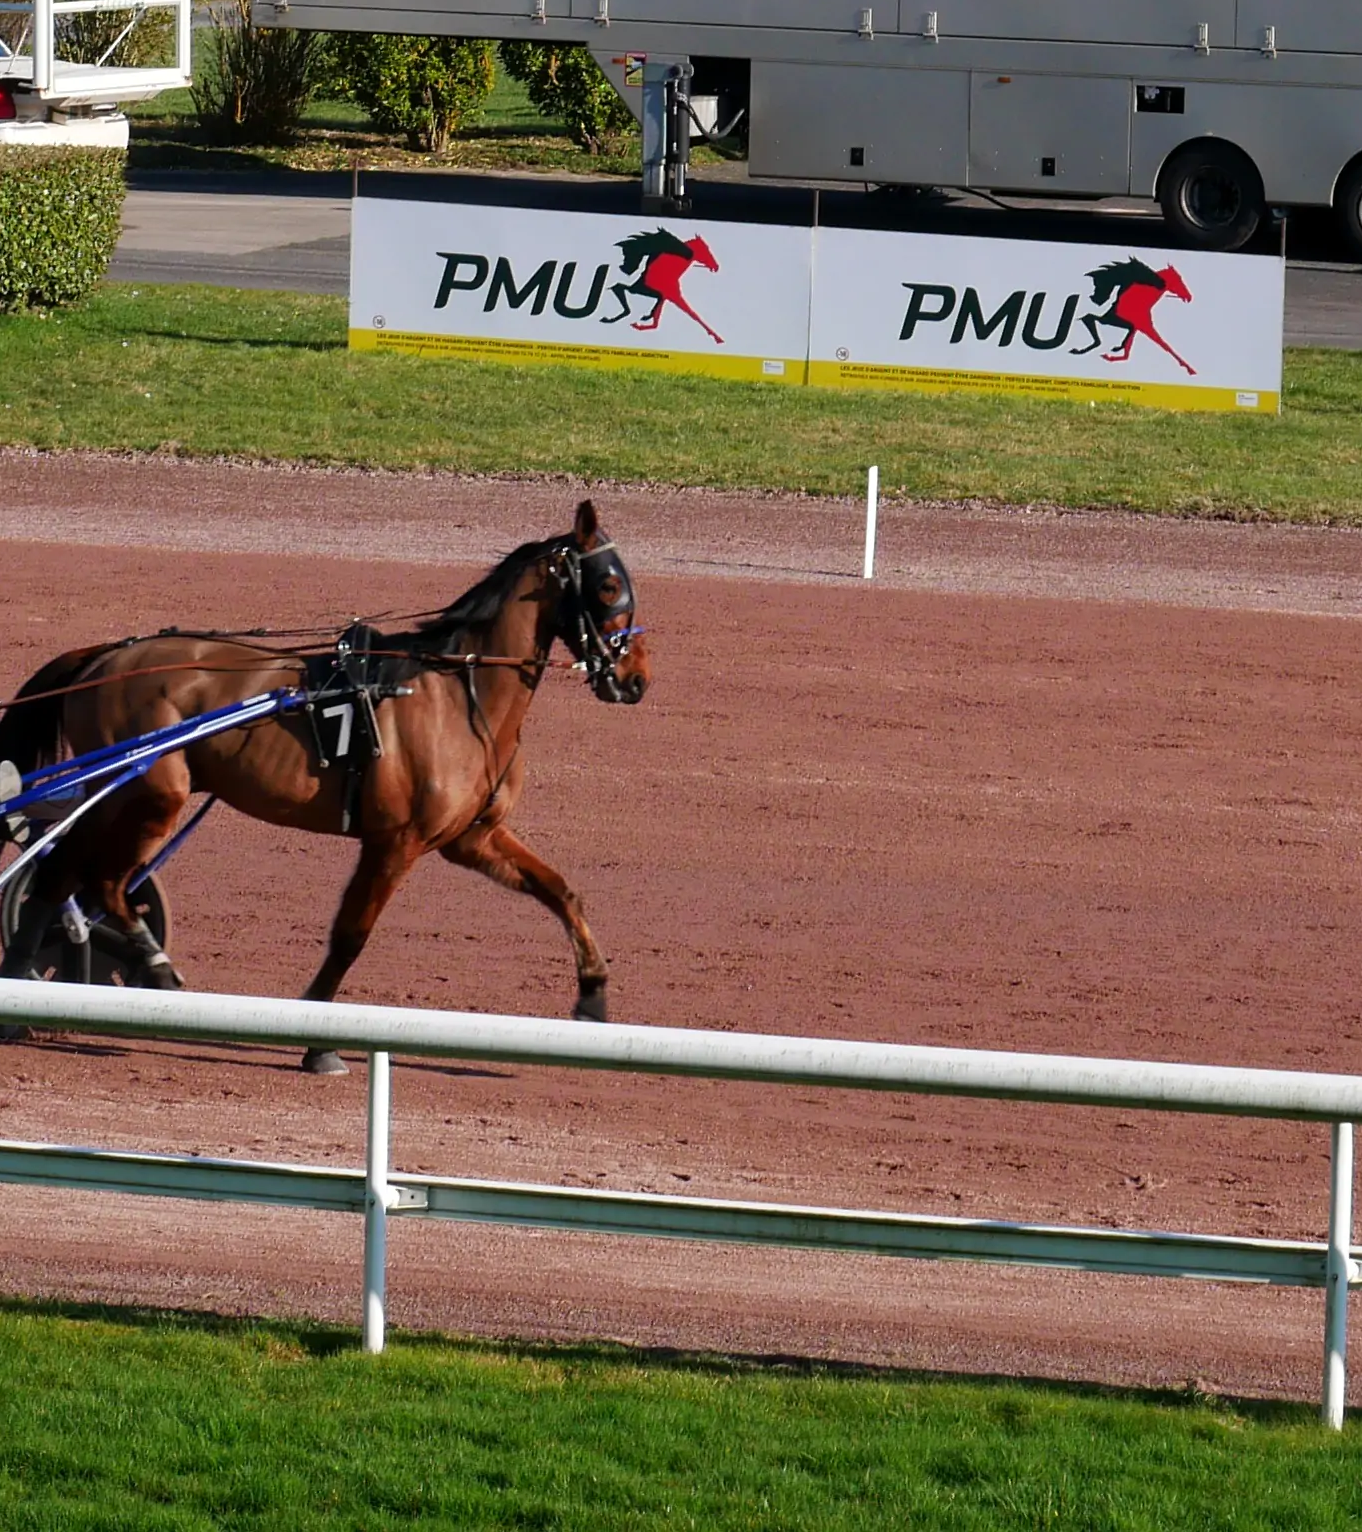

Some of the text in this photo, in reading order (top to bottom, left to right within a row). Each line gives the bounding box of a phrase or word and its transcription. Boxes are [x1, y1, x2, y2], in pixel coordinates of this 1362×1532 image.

[434, 252, 610, 319] PMU
[900, 283, 1080, 350] PMU
[322, 702, 354, 758] 7
